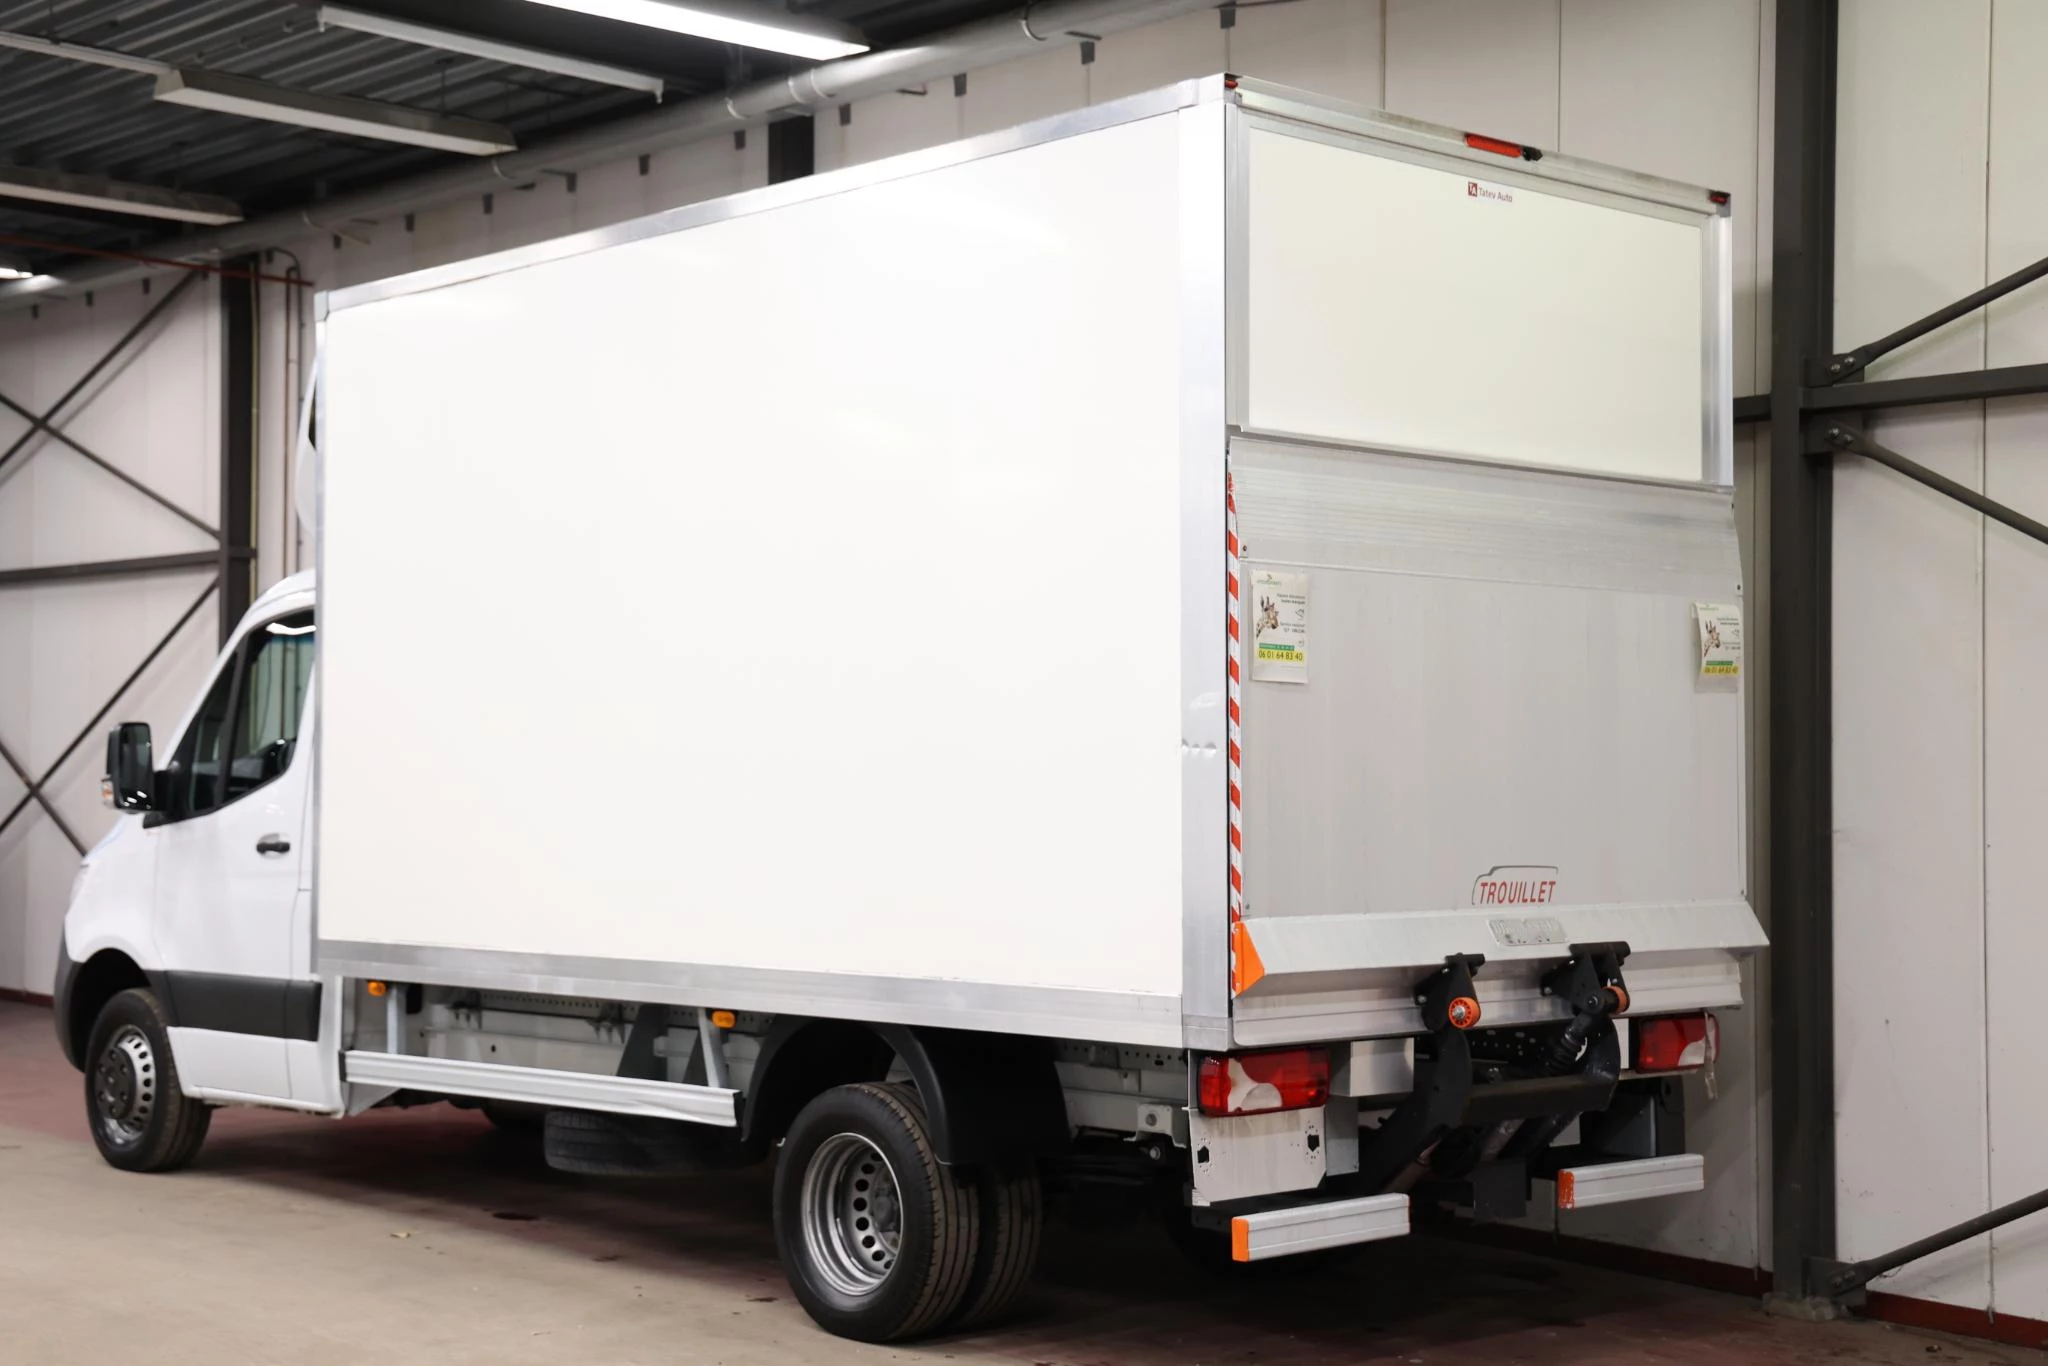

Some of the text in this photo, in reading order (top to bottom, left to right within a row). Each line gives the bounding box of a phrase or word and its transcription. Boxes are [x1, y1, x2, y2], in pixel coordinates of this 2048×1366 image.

[1479, 187, 1496, 200] Tatev
[1497, 191, 1513, 203] Auto
[1275, 651, 1284, 659] 64
[1294, 652, 1303, 661] 40
[1480, 881, 1556, 905] TROUILLET
